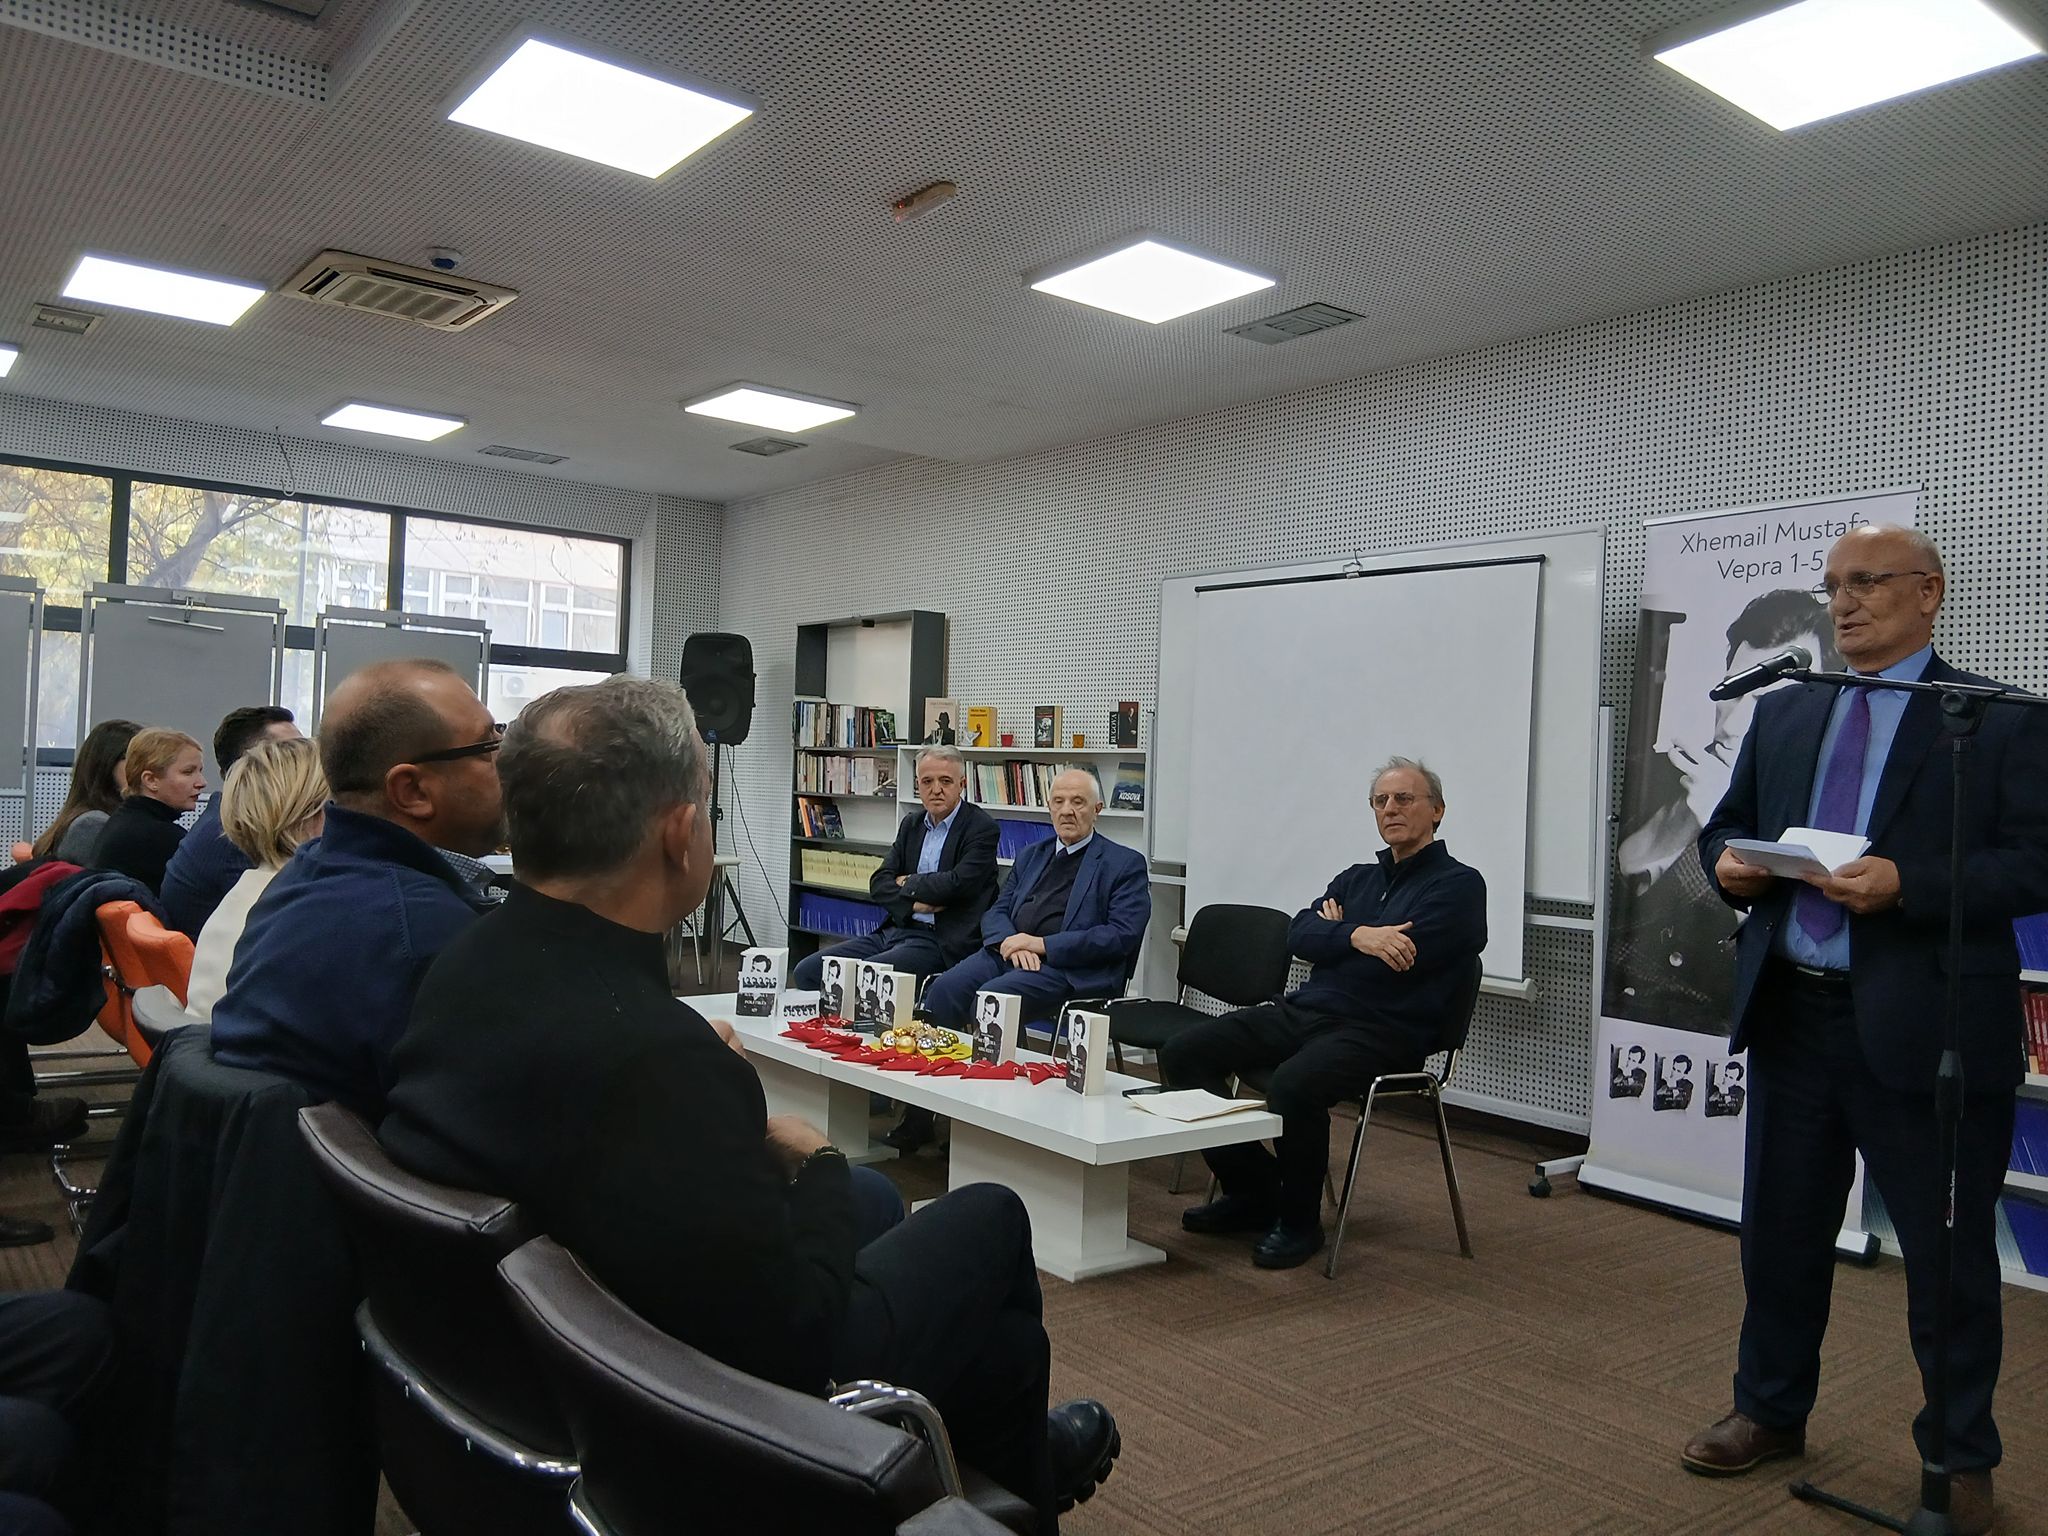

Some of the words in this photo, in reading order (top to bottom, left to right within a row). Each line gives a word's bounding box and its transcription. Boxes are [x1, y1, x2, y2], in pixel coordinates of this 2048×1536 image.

[1680, 524, 1767, 555] Xhemail
[1717, 558, 1782, 583] Vepra
[1790, 550, 1824, 573] 1-5
[1118, 791, 1141, 801] KOSOVA
